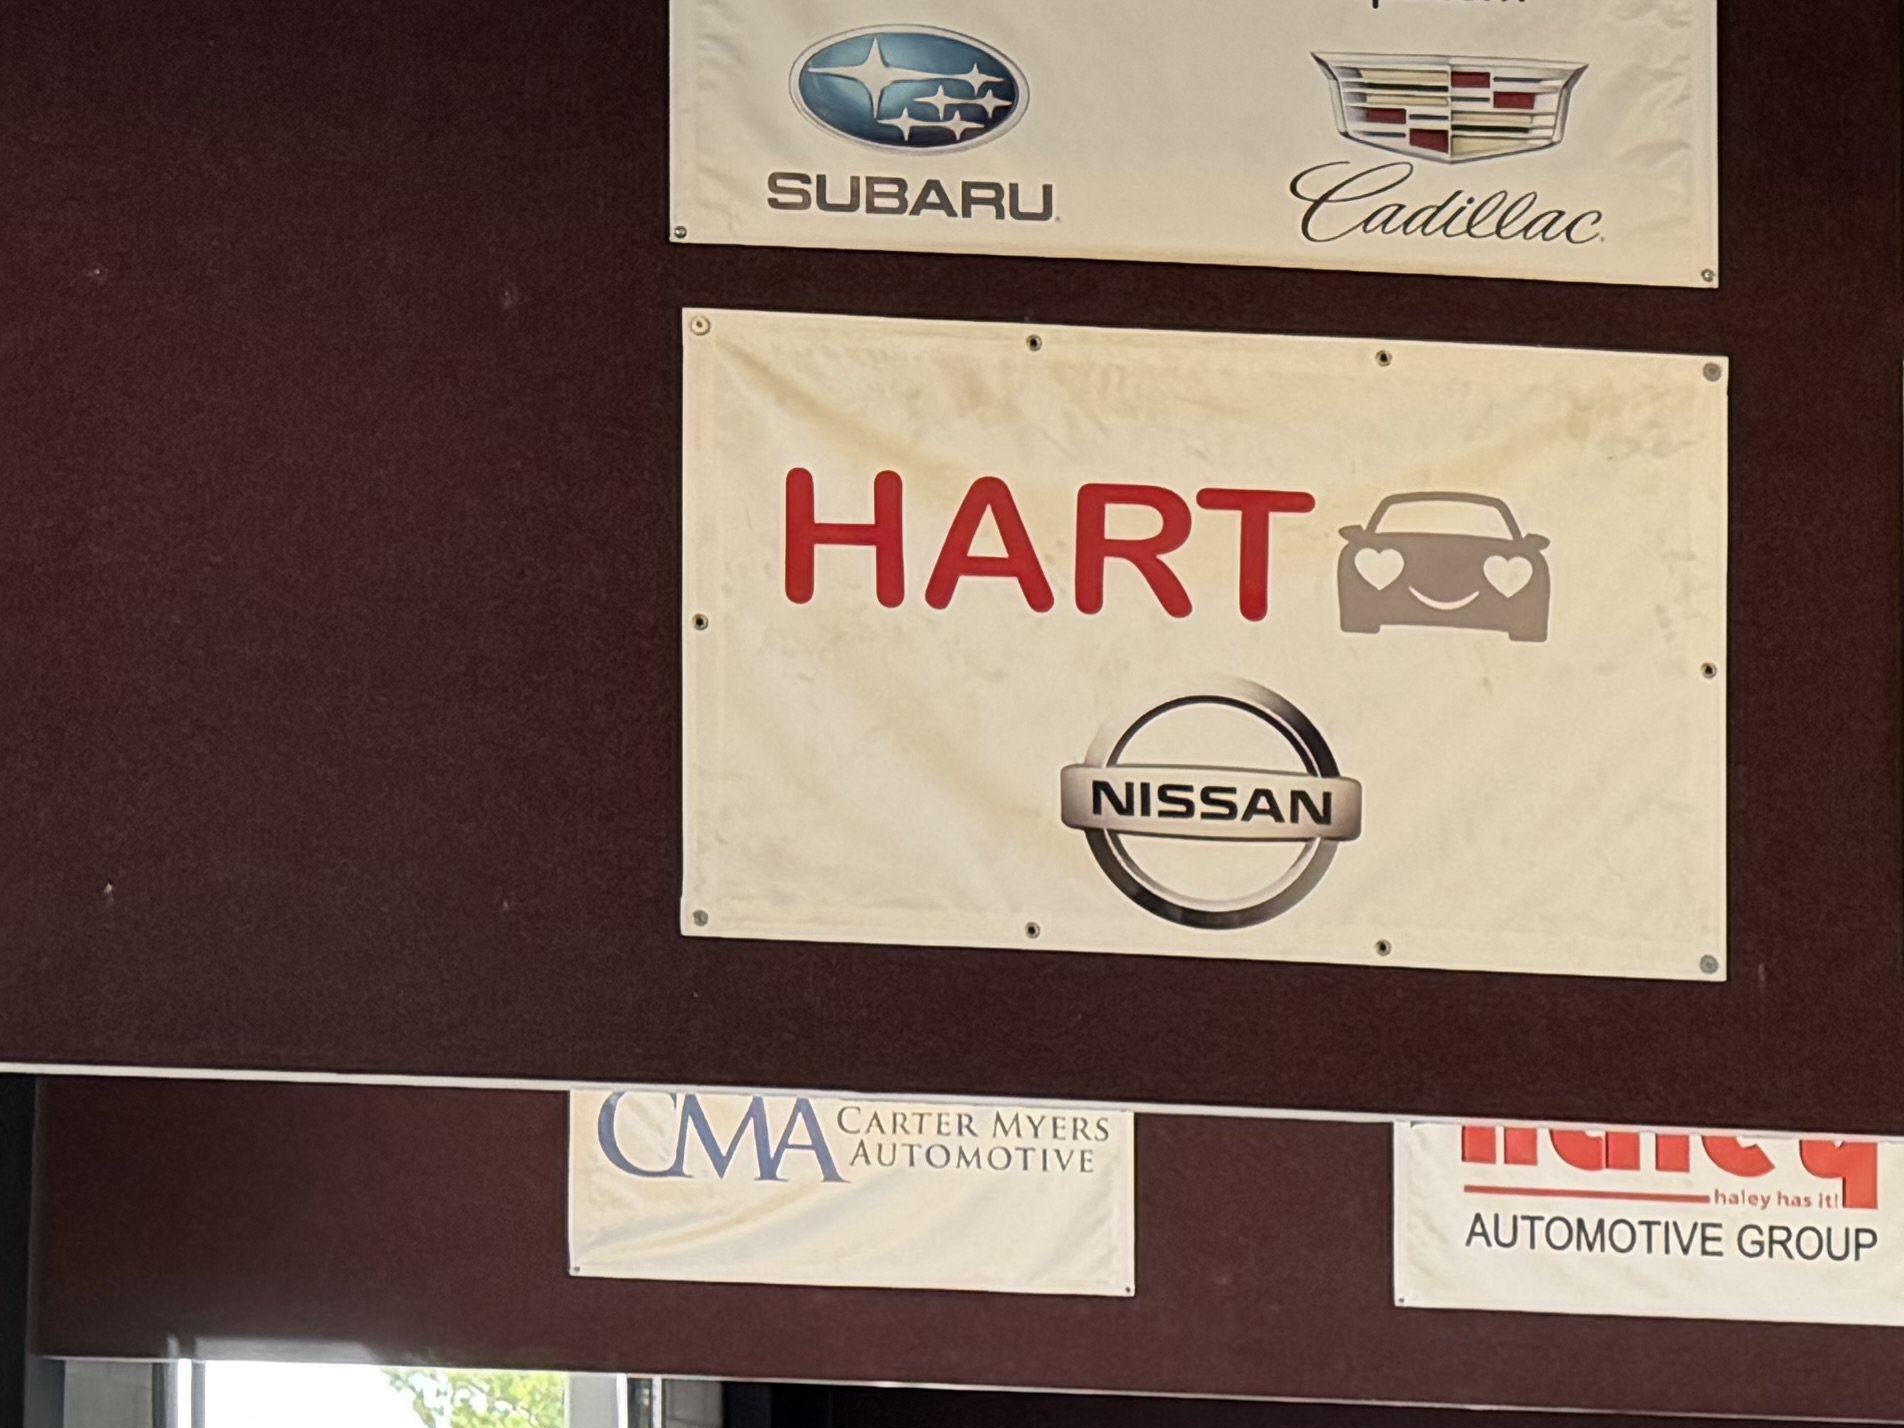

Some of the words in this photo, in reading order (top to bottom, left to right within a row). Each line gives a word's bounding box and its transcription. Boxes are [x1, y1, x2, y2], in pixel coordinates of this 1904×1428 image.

[767, 171, 1054, 222] SUBARU
[1289, 160, 1604, 246] Cadillac
[785, 467, 1315, 621] HART
[1091, 781, 1332, 825] NISSAN
[597, 1091, 851, 1183] CMA
[837, 1106, 978, 1137] CARTER
[992, 1111, 1110, 1142] MYERS
[850, 1139, 1095, 1173] AUTOMOTIVE
[1714, 1188, 1771, 1210] haley
[1777, 1190, 1812, 1207] has
[1465, 1213, 1723, 1257] AUTOMOTIVE
[1737, 1225, 1880, 1262] GROUP
